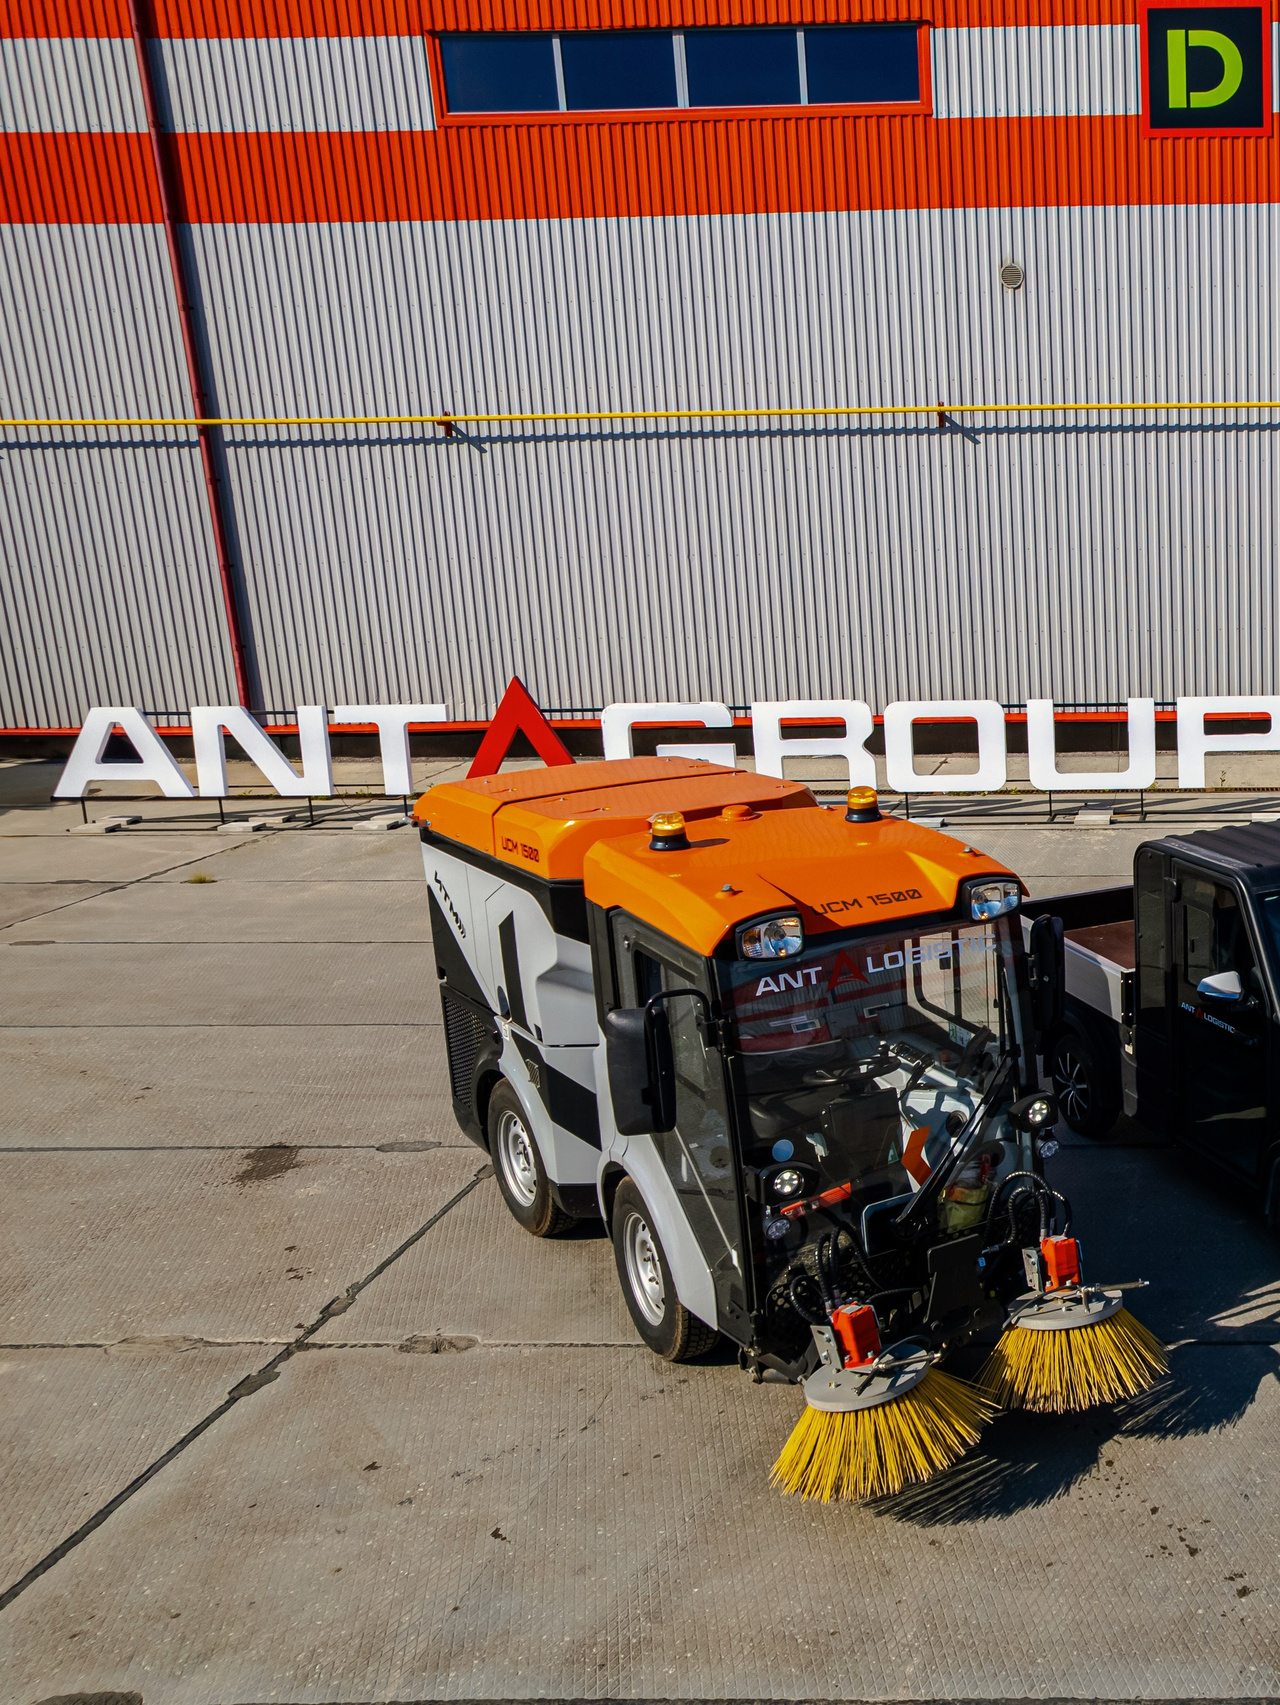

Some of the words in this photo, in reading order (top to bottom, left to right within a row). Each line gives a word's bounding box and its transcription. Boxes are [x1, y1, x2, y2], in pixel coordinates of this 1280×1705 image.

[1166, 29, 1243, 109] D
[53, 704, 450, 797] ANT
[501, 836, 519, 855] UCM
[520, 843, 540, 863] 1500
[810, 899, 863, 915] UCM
[867, 888, 923, 907] 1500
[756, 966, 823, 997] ANT
[867, 933, 997, 973] LOGISTIC
[1181, 1002, 1195, 1013] ANT
[1203, 1012, 1235, 1034] LOGISTIC
